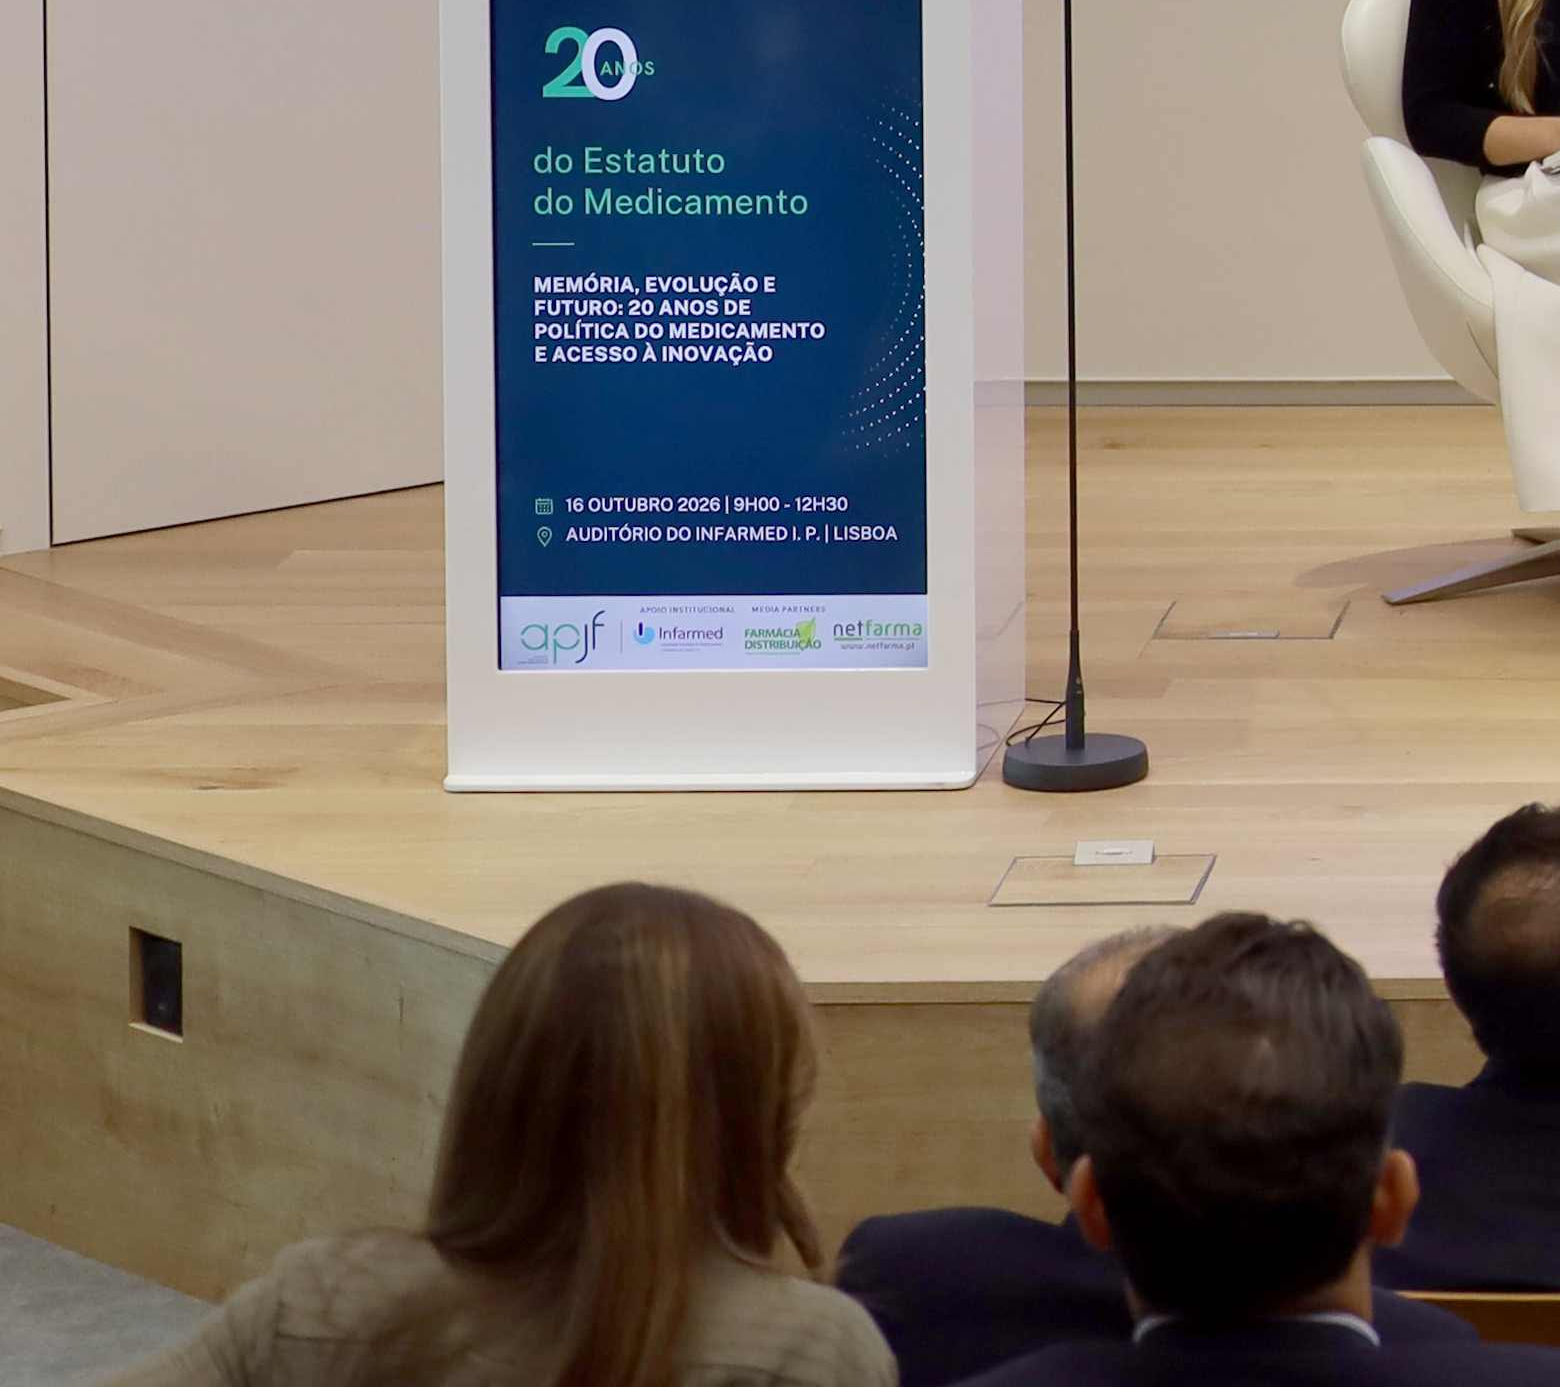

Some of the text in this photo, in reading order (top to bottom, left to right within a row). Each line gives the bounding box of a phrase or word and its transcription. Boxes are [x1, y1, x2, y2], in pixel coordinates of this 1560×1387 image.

[542, 27, 638, 101] 20
[534, 146, 724, 173] do Estatuto
[535, 187, 807, 214] do Medicamento
[535, 273, 776, 296] MEMÓRIA, EVOLUÇÃO E
[535, 298, 751, 316] FUTURO: 20 ANOS DE
[535, 319, 825, 339] POLÍTICA DO MEDICAMENTO
[535, 338, 772, 366] E ACESSO À INOVAÇÃO
[566, 498, 584, 512] 16
[588, 498, 673, 512] OUTUBRO
[678, 497, 720, 511] 2026
[734, 497, 779, 511] 9H00
[795, 497, 848, 511] 12H30
[566, 523, 662, 541] AUDITÓRIO
[667, 527, 691, 541] DO
[696, 526, 787, 541] INFARMED
[834, 526, 897, 540] LISBOA
[660, 627, 723, 639] Infarmed
[745, 625, 802, 639] FARMÁCIA
[834, 620, 922, 638] netfarma
[745, 638, 821, 651] DISTRIBUIÇÃO
